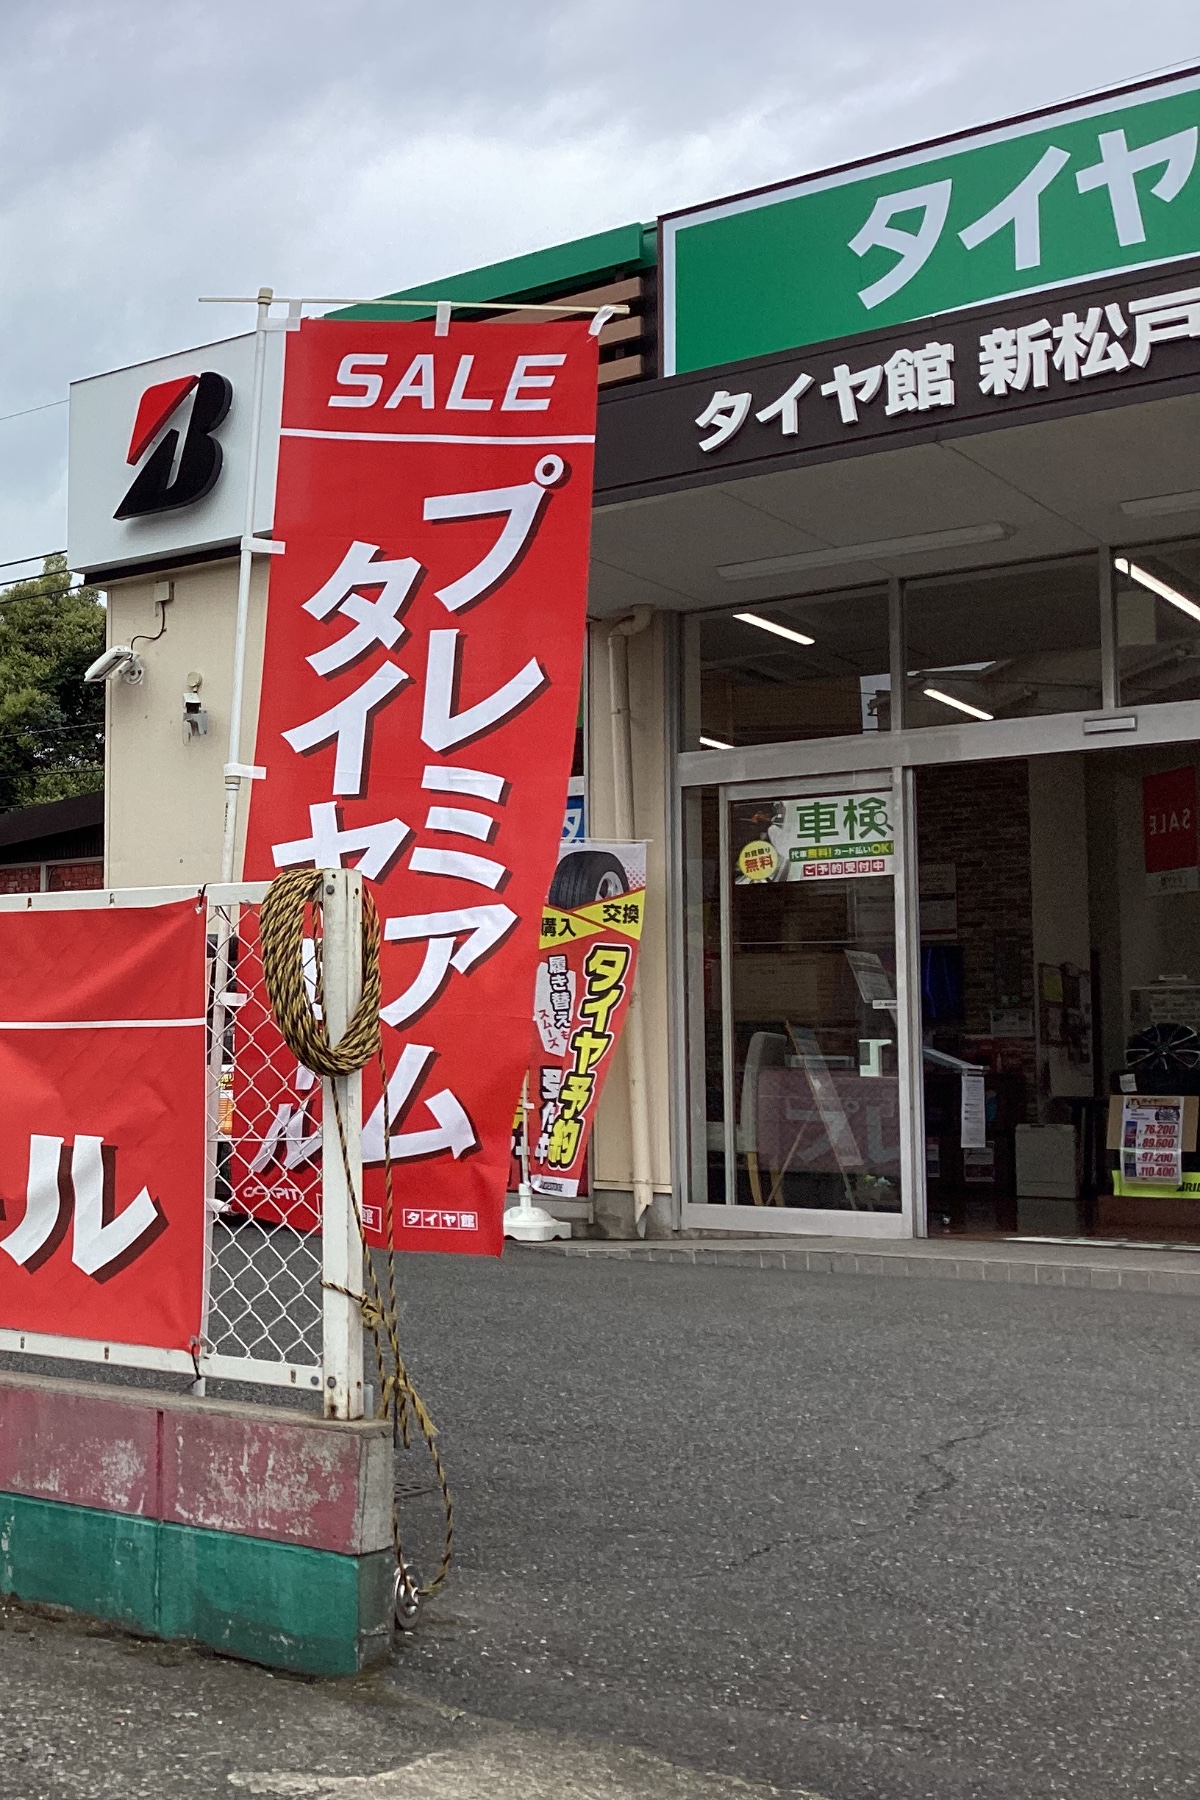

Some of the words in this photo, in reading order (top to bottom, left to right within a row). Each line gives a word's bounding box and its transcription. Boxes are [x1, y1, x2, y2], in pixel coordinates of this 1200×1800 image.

[847, 126, 1199, 310] タイヤ
[327, 353, 567, 412] SALE
[695, 341, 955, 452] タイヤ館
[978, 286, 1200, 396] 新松戸
[360, 453, 565, 1163] プレミアム
[796, 796, 893, 844] 車検
[744, 854, 774, 873] 無料
[803, 859, 885, 877] ご予約受付中
[540, 917, 577, 938] 購入
[602, 903, 640, 924] 交換
[546, 947, 631, 1167] タイヤ予約
[405, 1210, 477, 1228] タイヤ館
